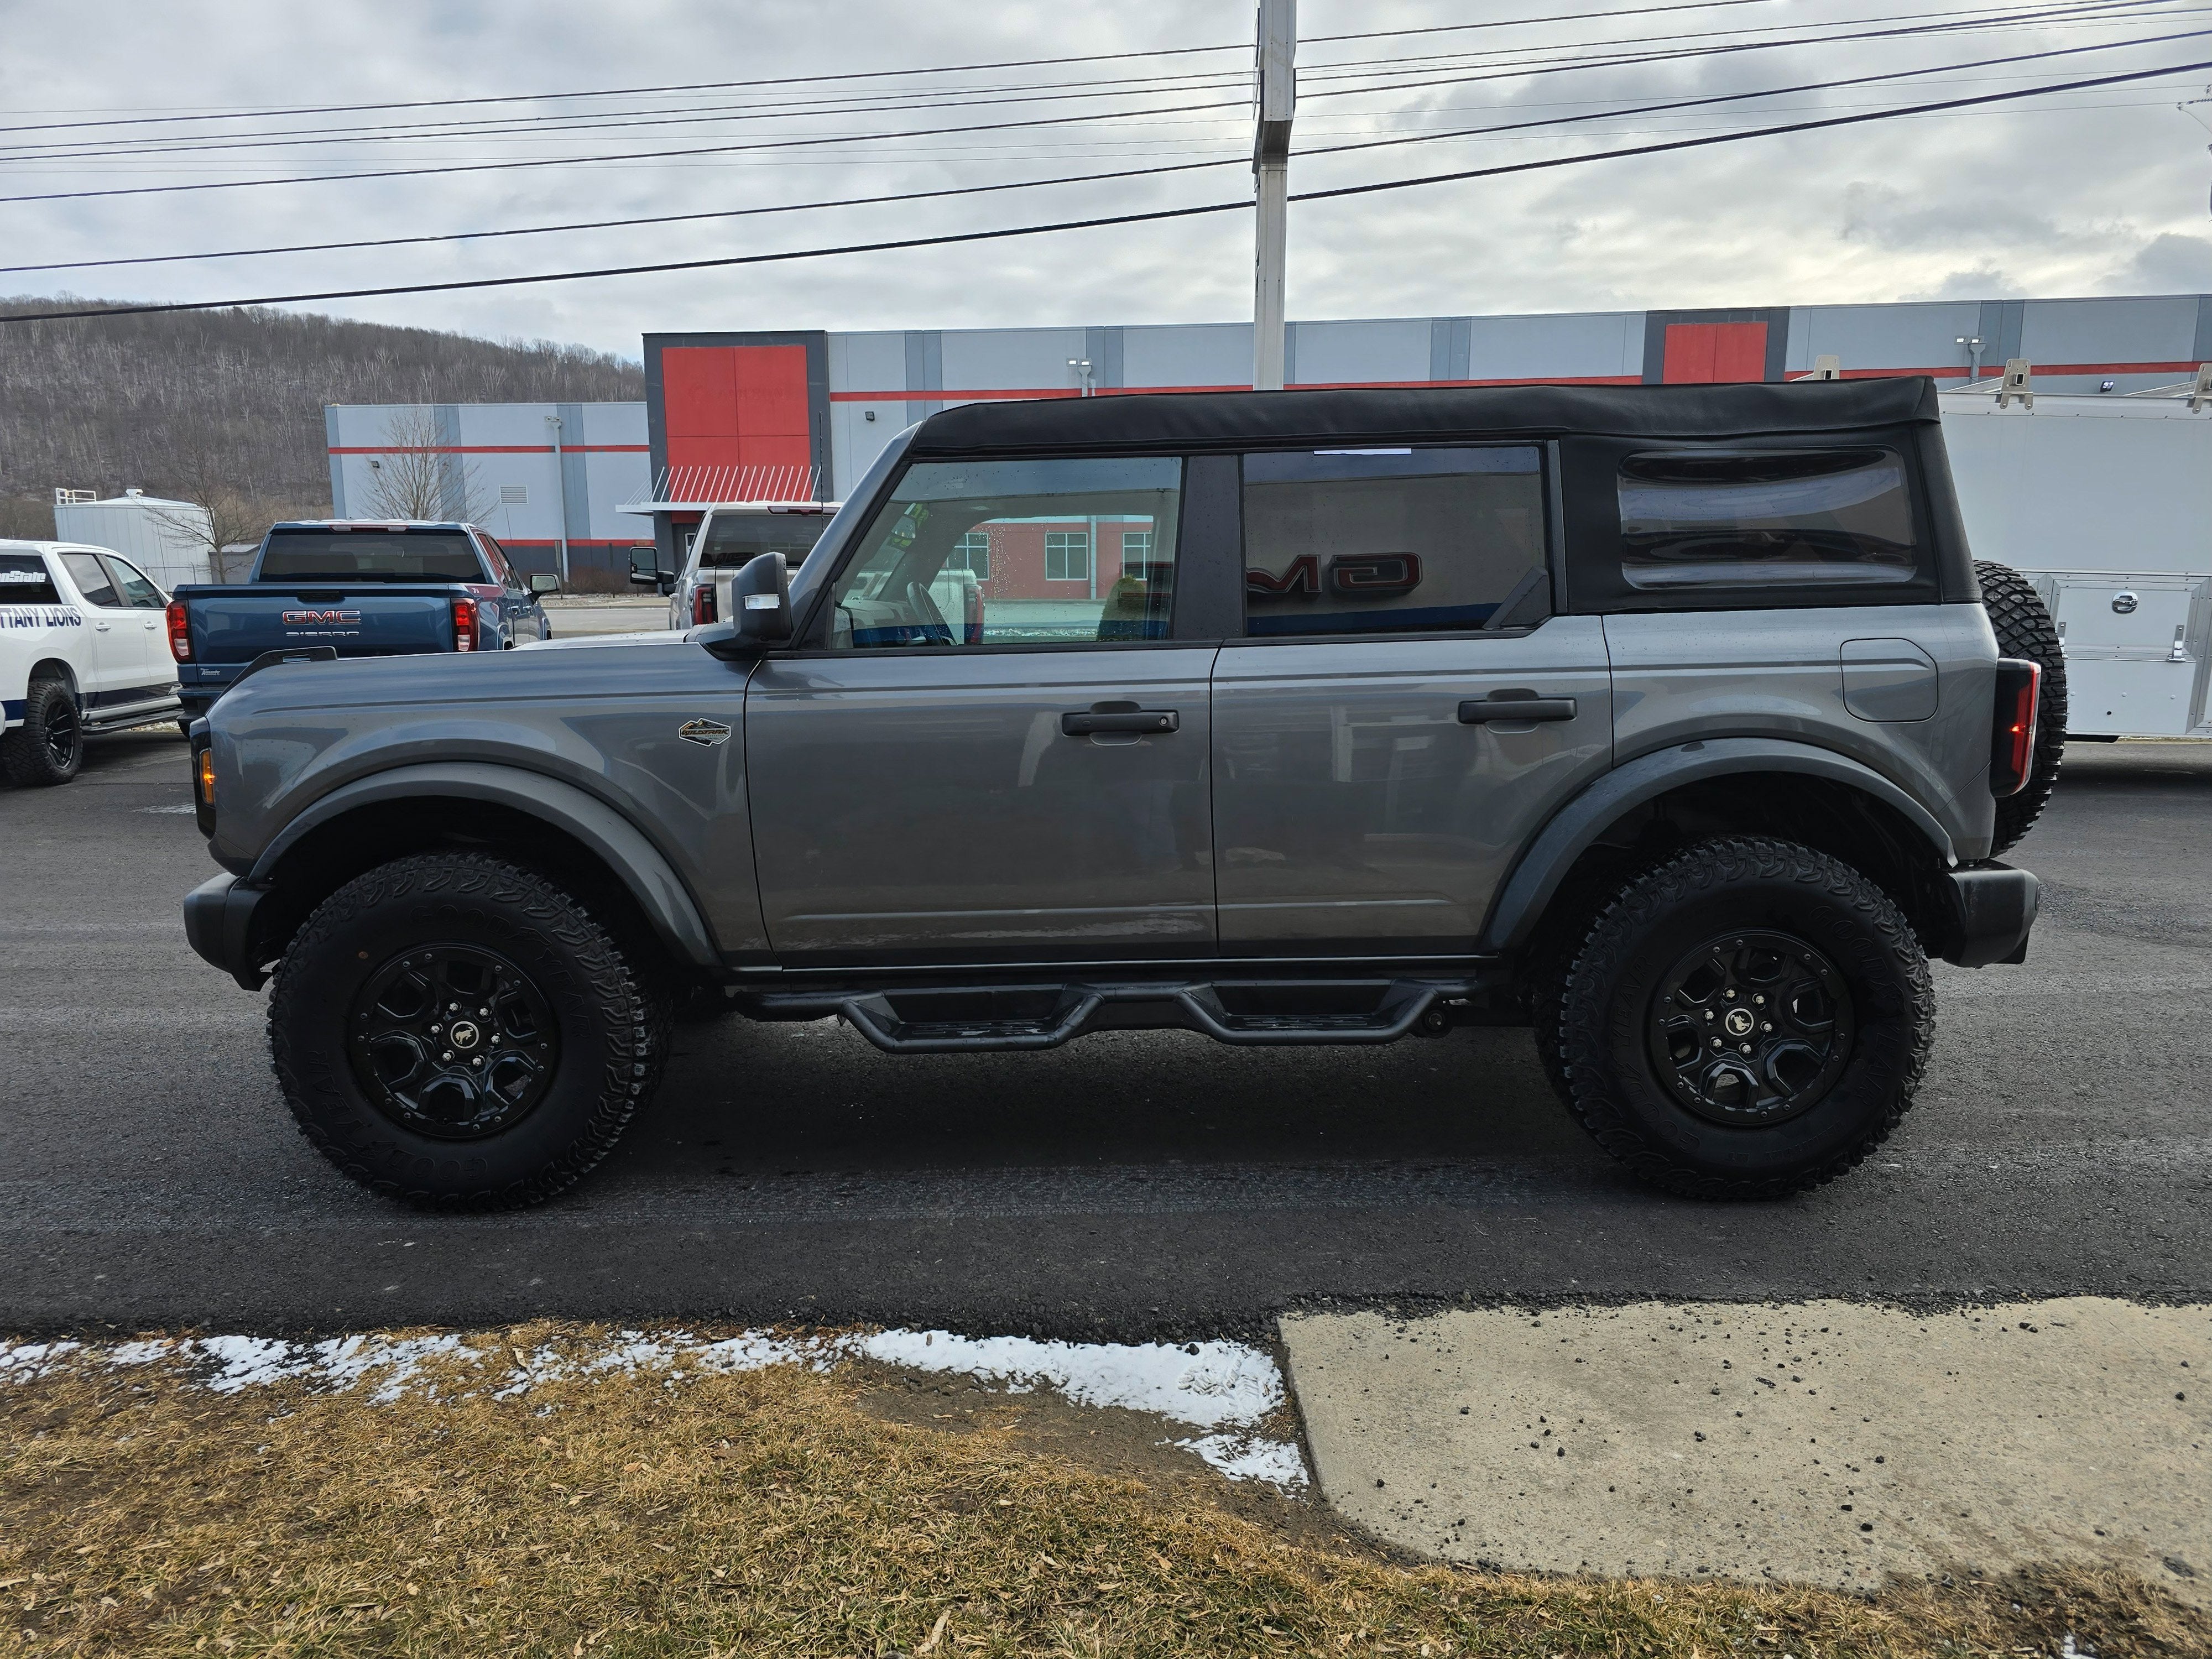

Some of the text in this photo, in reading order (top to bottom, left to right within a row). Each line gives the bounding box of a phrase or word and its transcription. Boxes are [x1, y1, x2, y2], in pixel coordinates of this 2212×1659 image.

[0, 570, 46, 583] nState
[41, 607, 81, 627] LIONS
[282, 610, 362, 625] GMC
